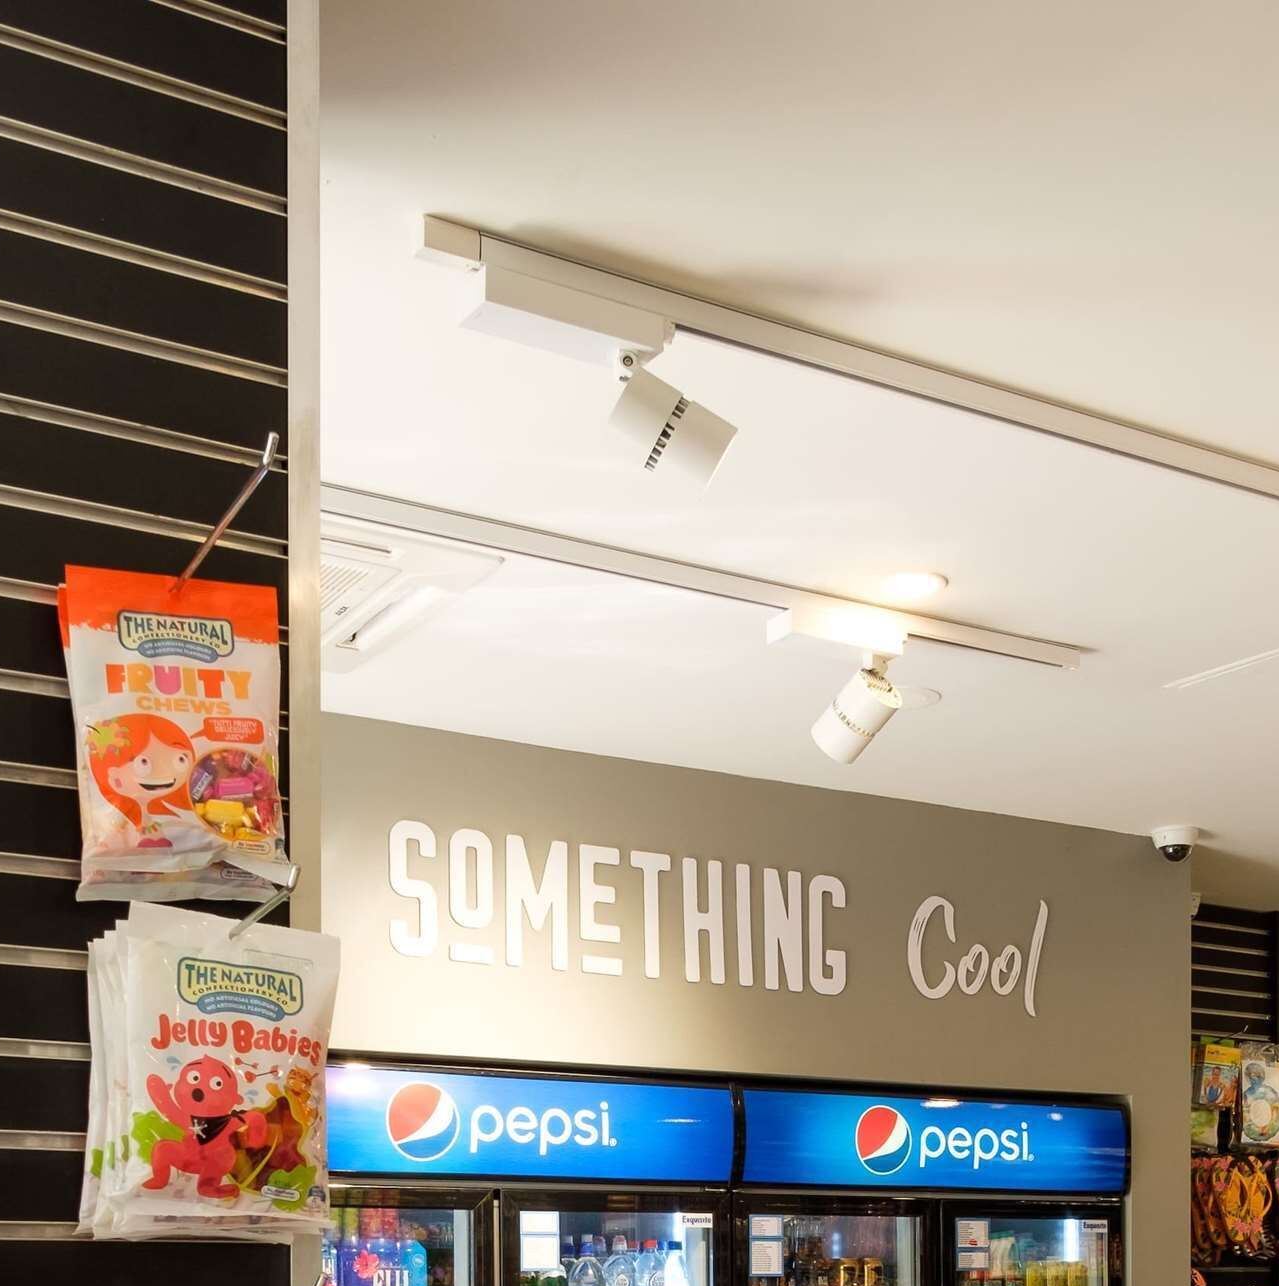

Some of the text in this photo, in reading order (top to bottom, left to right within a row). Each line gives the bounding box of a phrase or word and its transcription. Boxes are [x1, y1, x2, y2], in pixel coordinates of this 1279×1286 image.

[123, 616, 228, 645] THE NATURAL
[106, 663, 252, 699] FRUITY
[135, 696, 232, 715] CHEWS
[389, 820, 1048, 1016] SOMETHING Cool
[185, 964, 297, 1002] THE NATURAL
[151, 1014, 322, 1066] Jelly Babies
[469, 1102, 609, 1159] pepsi
[920, 1122, 1029, 1169] pepsi
